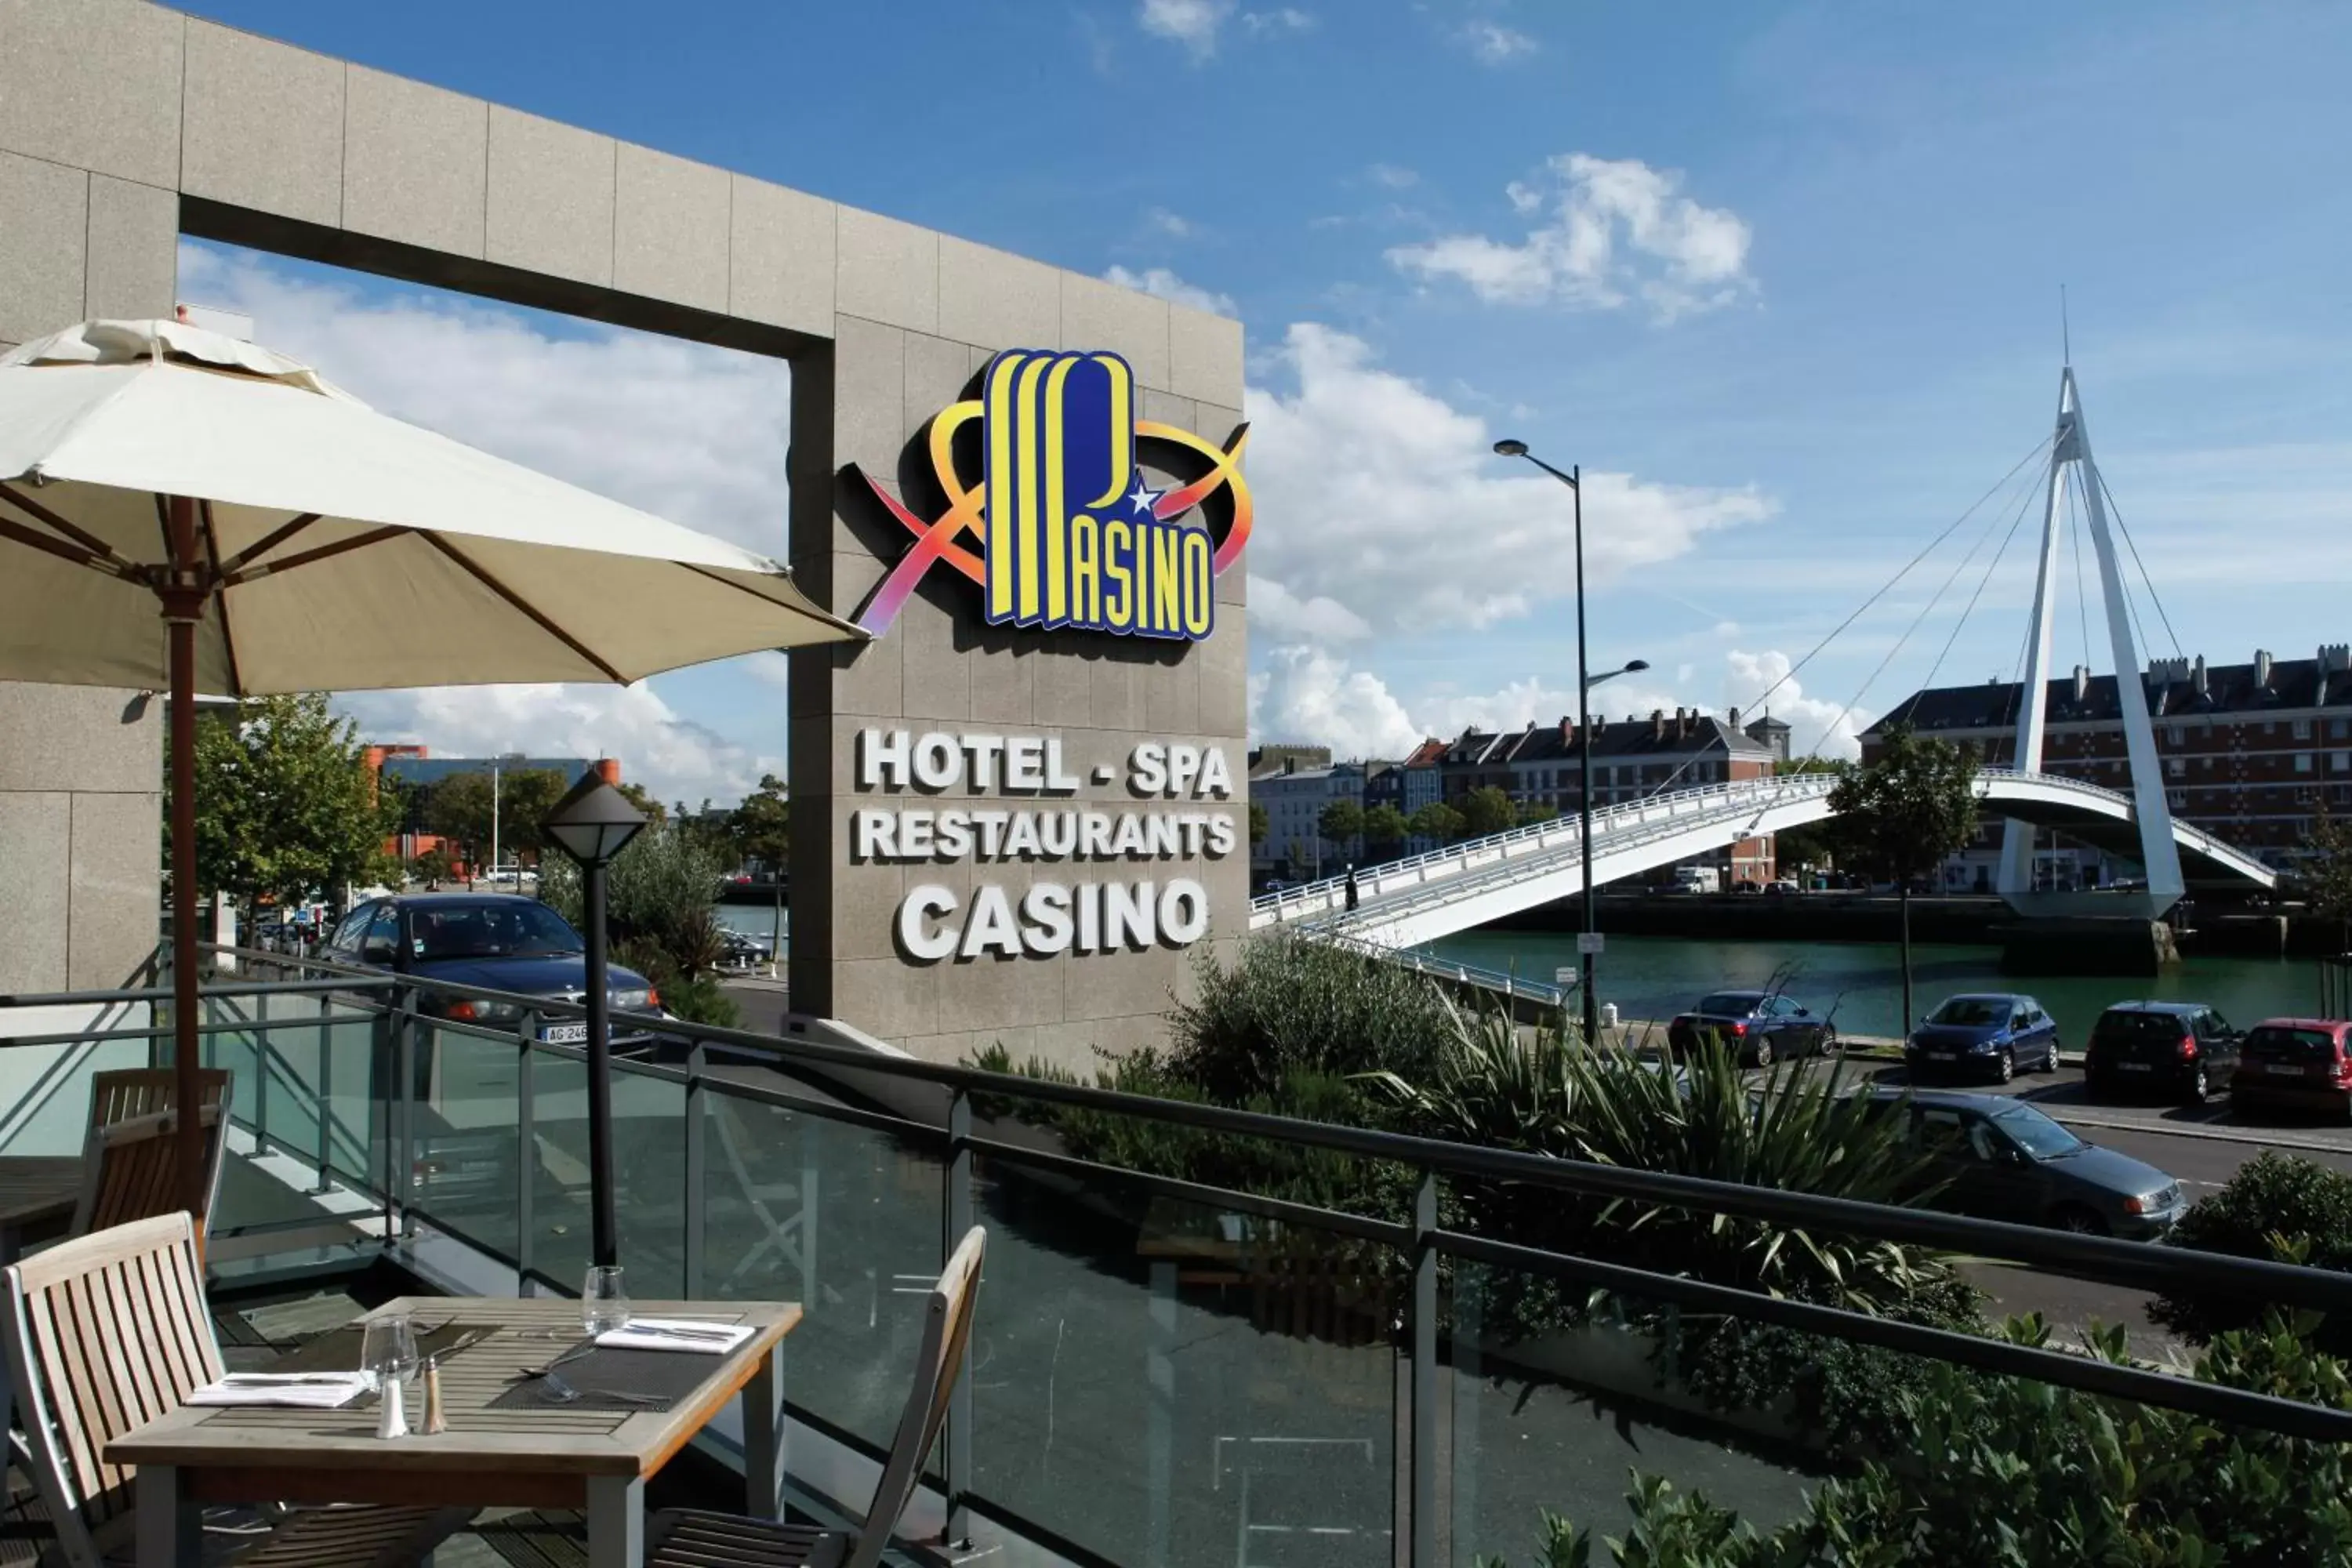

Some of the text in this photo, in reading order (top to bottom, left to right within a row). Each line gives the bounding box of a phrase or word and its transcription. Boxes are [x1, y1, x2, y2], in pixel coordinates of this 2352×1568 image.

[862, 728, 1080, 790] HOTEL
[1133, 743, 1232, 794] SPA
[858, 809, 1236, 858] RESTAURANTS
[900, 878, 1209, 959] CASINO
